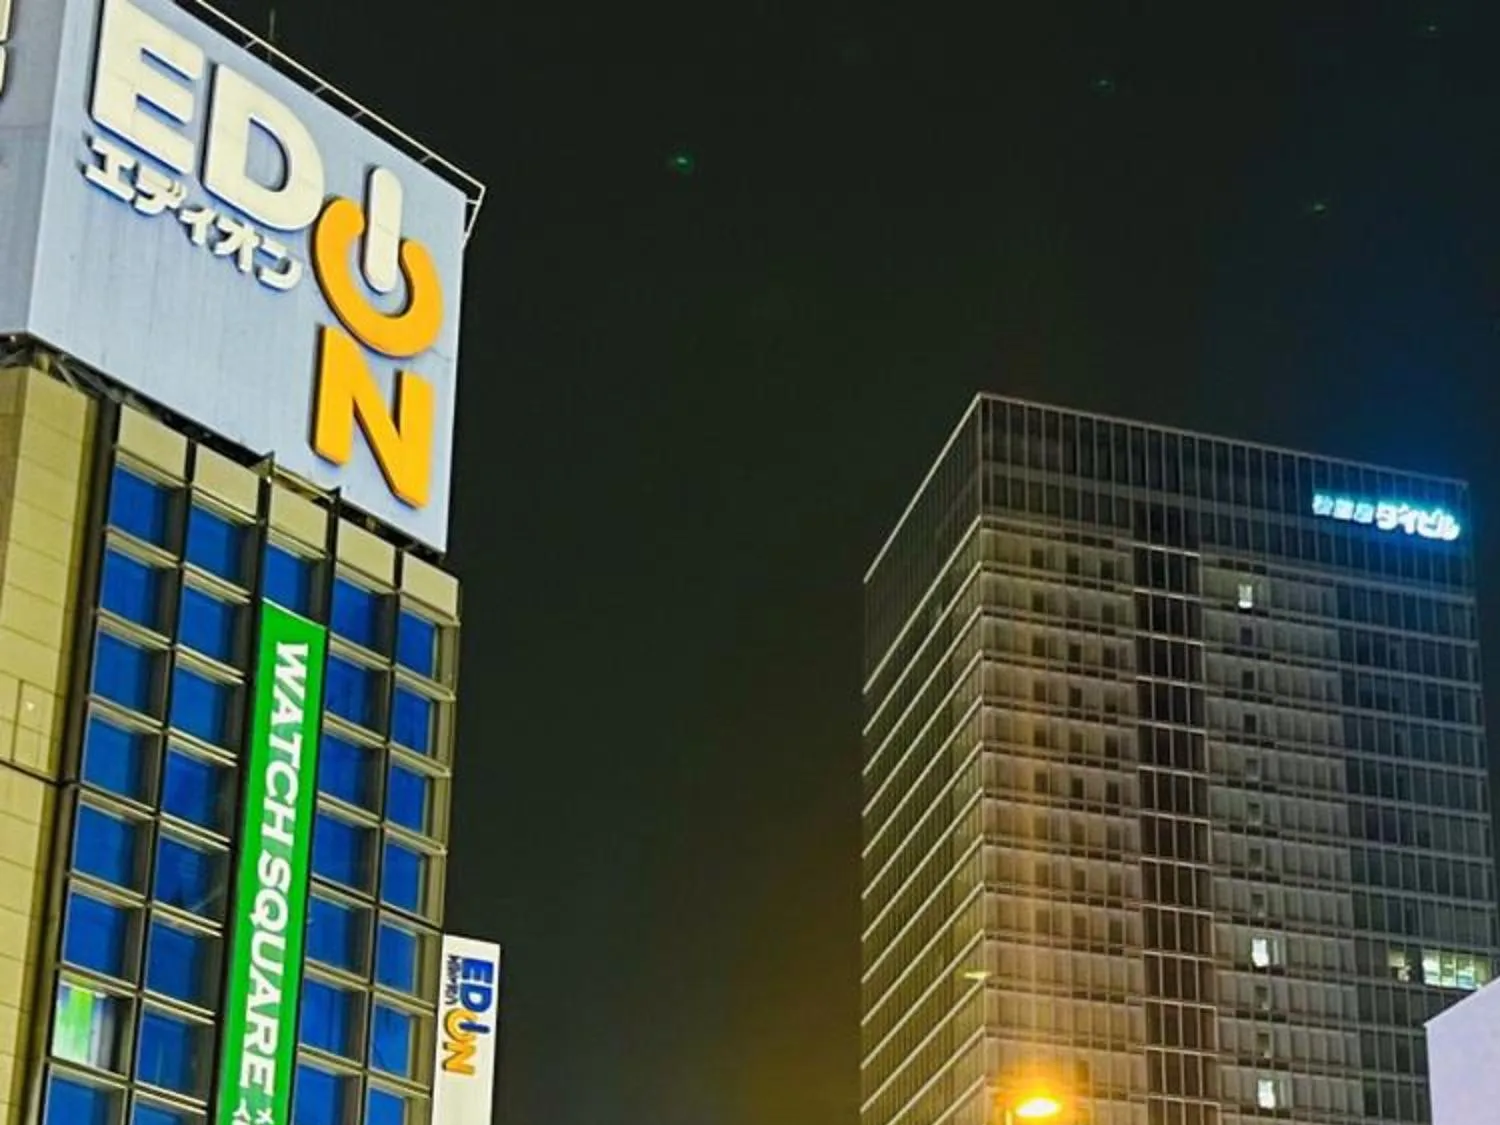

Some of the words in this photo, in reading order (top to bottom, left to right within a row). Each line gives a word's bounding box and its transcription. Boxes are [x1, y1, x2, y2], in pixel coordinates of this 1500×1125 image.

[85, 140, 301, 291] エディオン
[92, 0, 443, 509] EDION
[262, 641, 309, 846] WATCH
[238, 850, 293, 1095] SQUARE
[442, 957, 494, 1077] EDION
